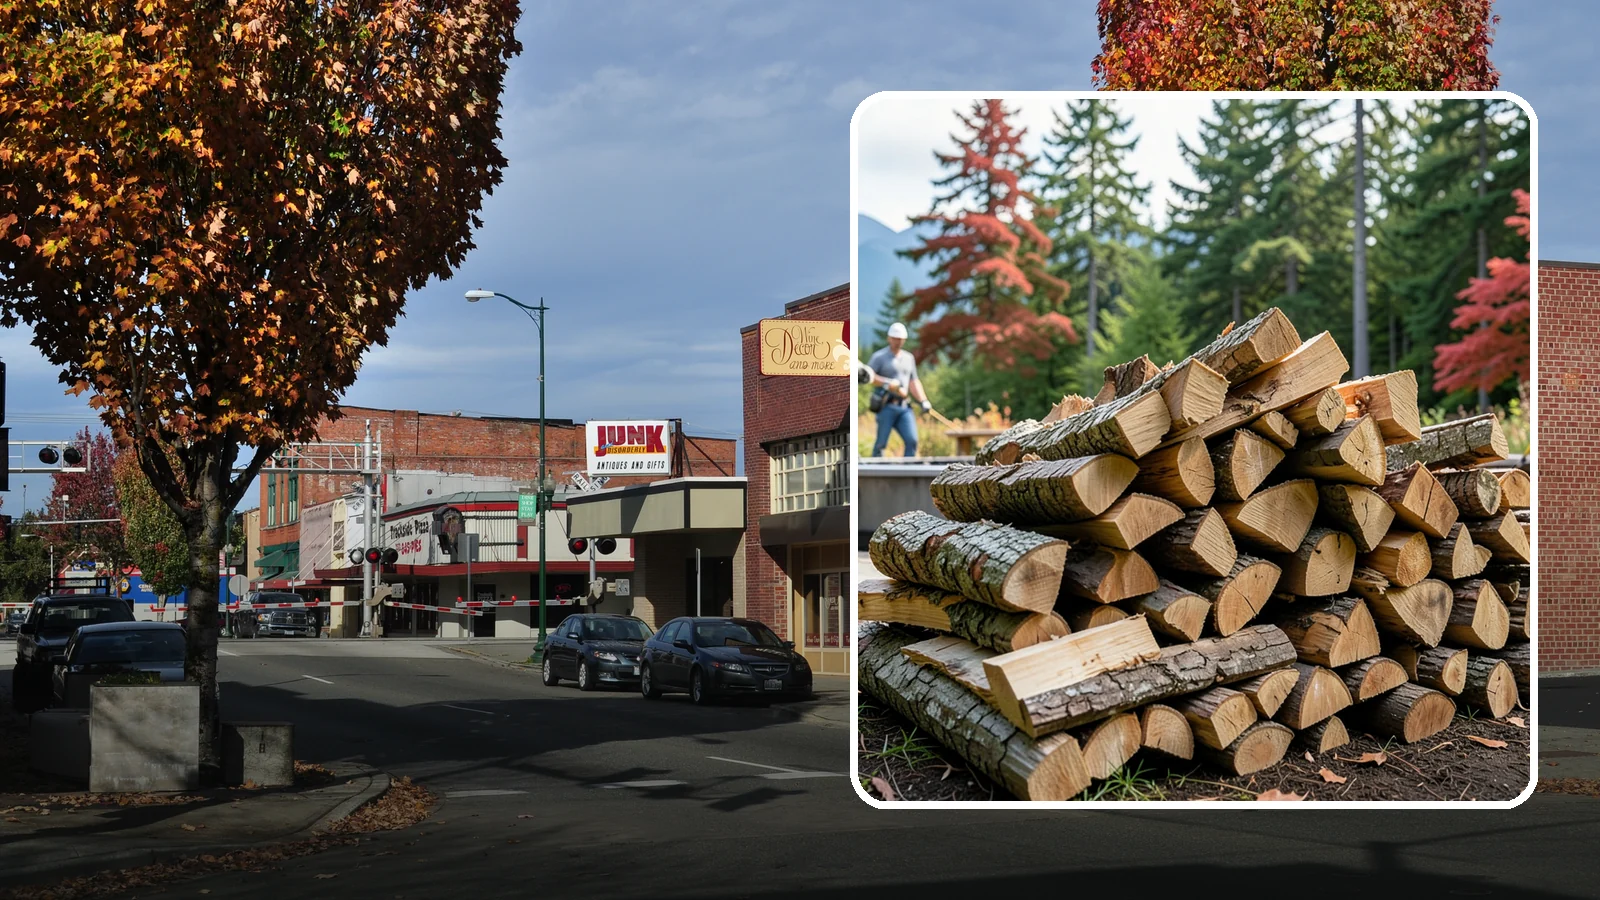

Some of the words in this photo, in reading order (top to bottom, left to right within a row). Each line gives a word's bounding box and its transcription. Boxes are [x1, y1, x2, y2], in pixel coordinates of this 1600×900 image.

[595, 425, 664, 457] JUNK
[607, 446, 646, 454] DISORDERLY
[597, 461, 628, 470] ANTIQUES
[631, 461, 644, 470] AND
[647, 460, 665, 470] GIFTS
[414, 519, 429, 534] Pizza
